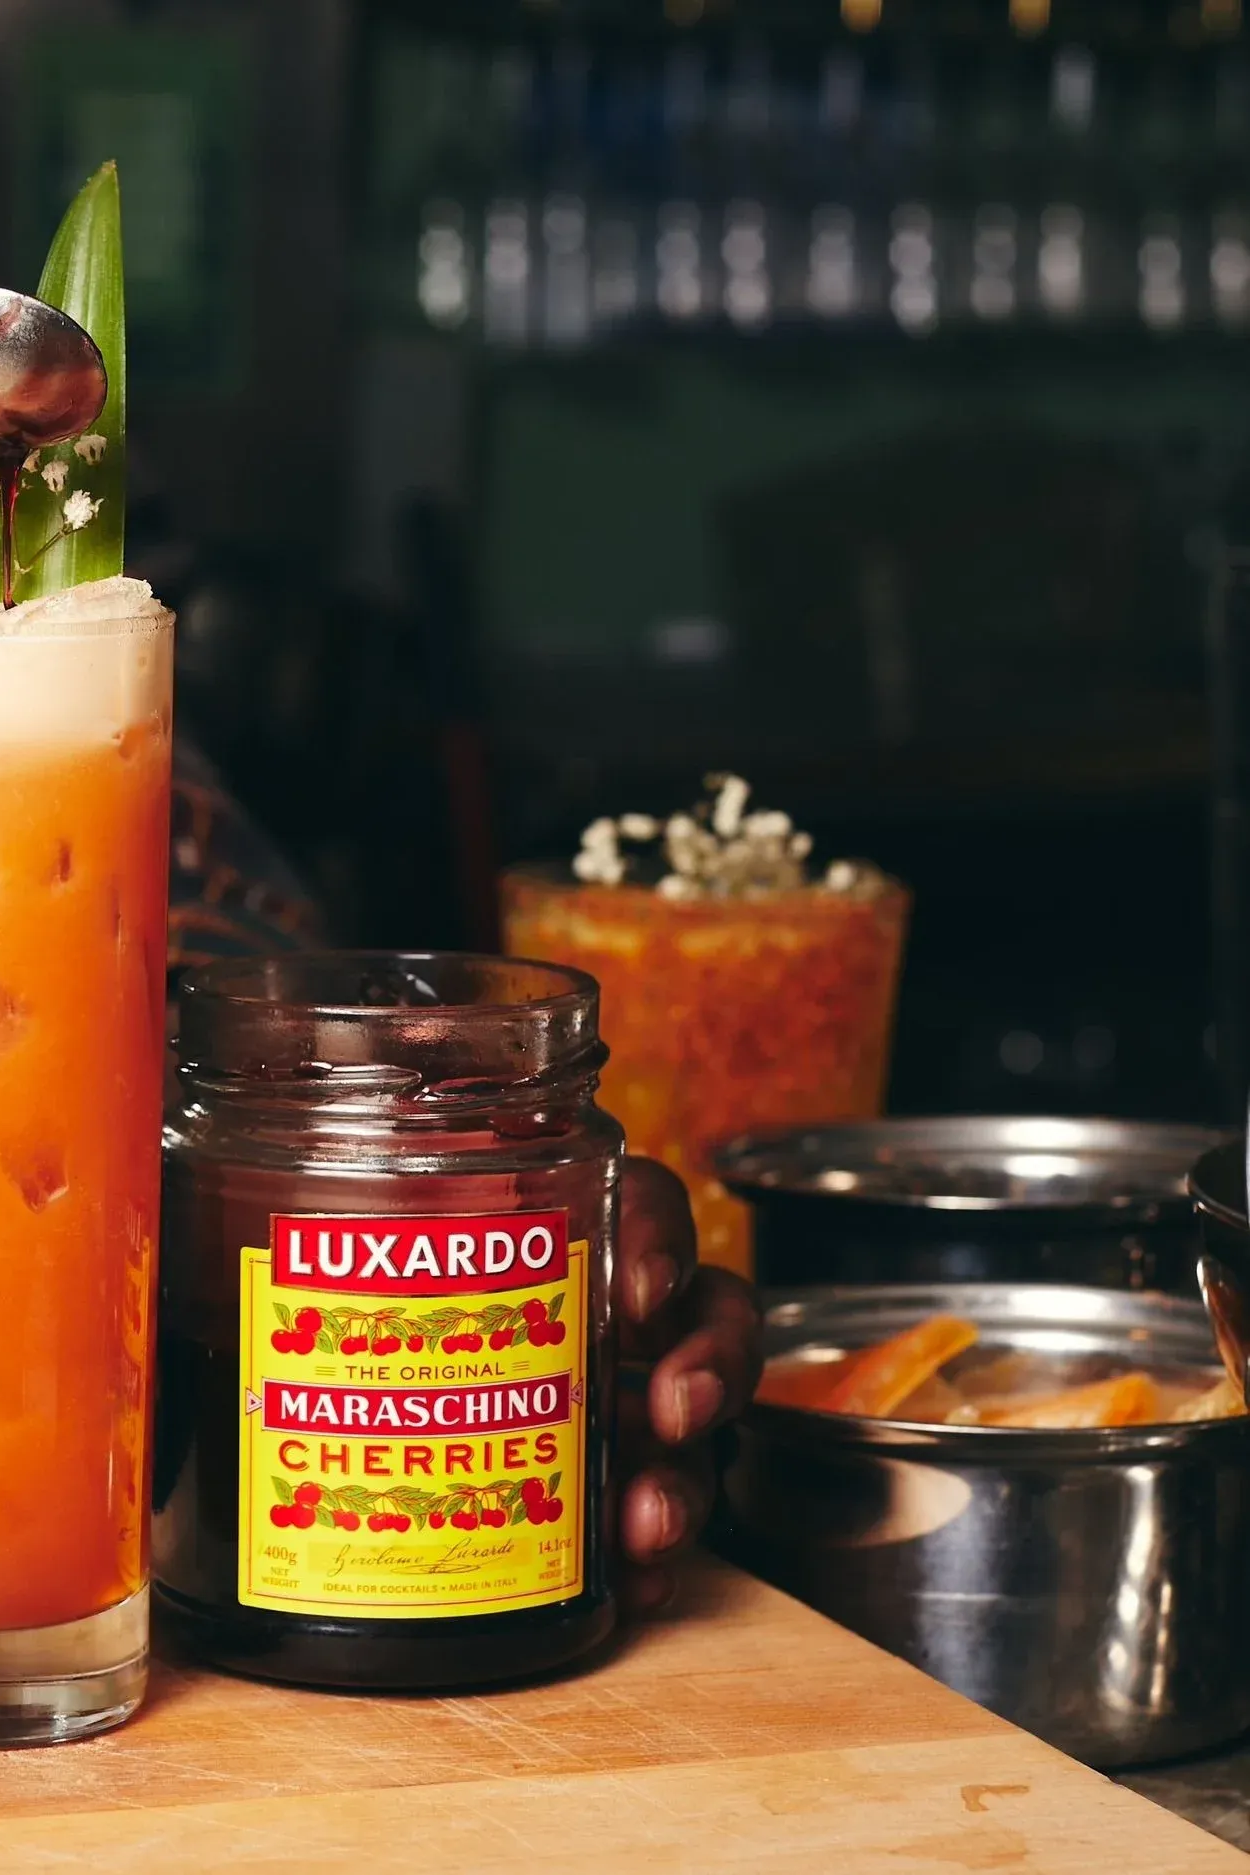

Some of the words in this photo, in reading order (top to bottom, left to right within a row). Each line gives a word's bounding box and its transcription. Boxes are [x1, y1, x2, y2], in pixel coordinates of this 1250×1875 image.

[289, 1226, 554, 1278] LUXARDO
[345, 1365, 391, 1381] THE
[400, 1363, 506, 1381] ORIGINAL
[280, 1384, 557, 1427] MARASCHINO
[278, 1432, 558, 1476] CHERRIES
[263, 1545, 298, 1566] 400g
[270, 1566, 290, 1576] NET
[261, 1576, 300, 1589] WEIGHT
[323, 1582, 353, 1593] IDEAL
[356, 1584, 377, 1593] FOR
[380, 1584, 438, 1594] COCKTAILS
[449, 1582, 478, 1592] MADE
[481, 1581, 491, 1589] IN
[493, 1578, 518, 1588] ITALY
